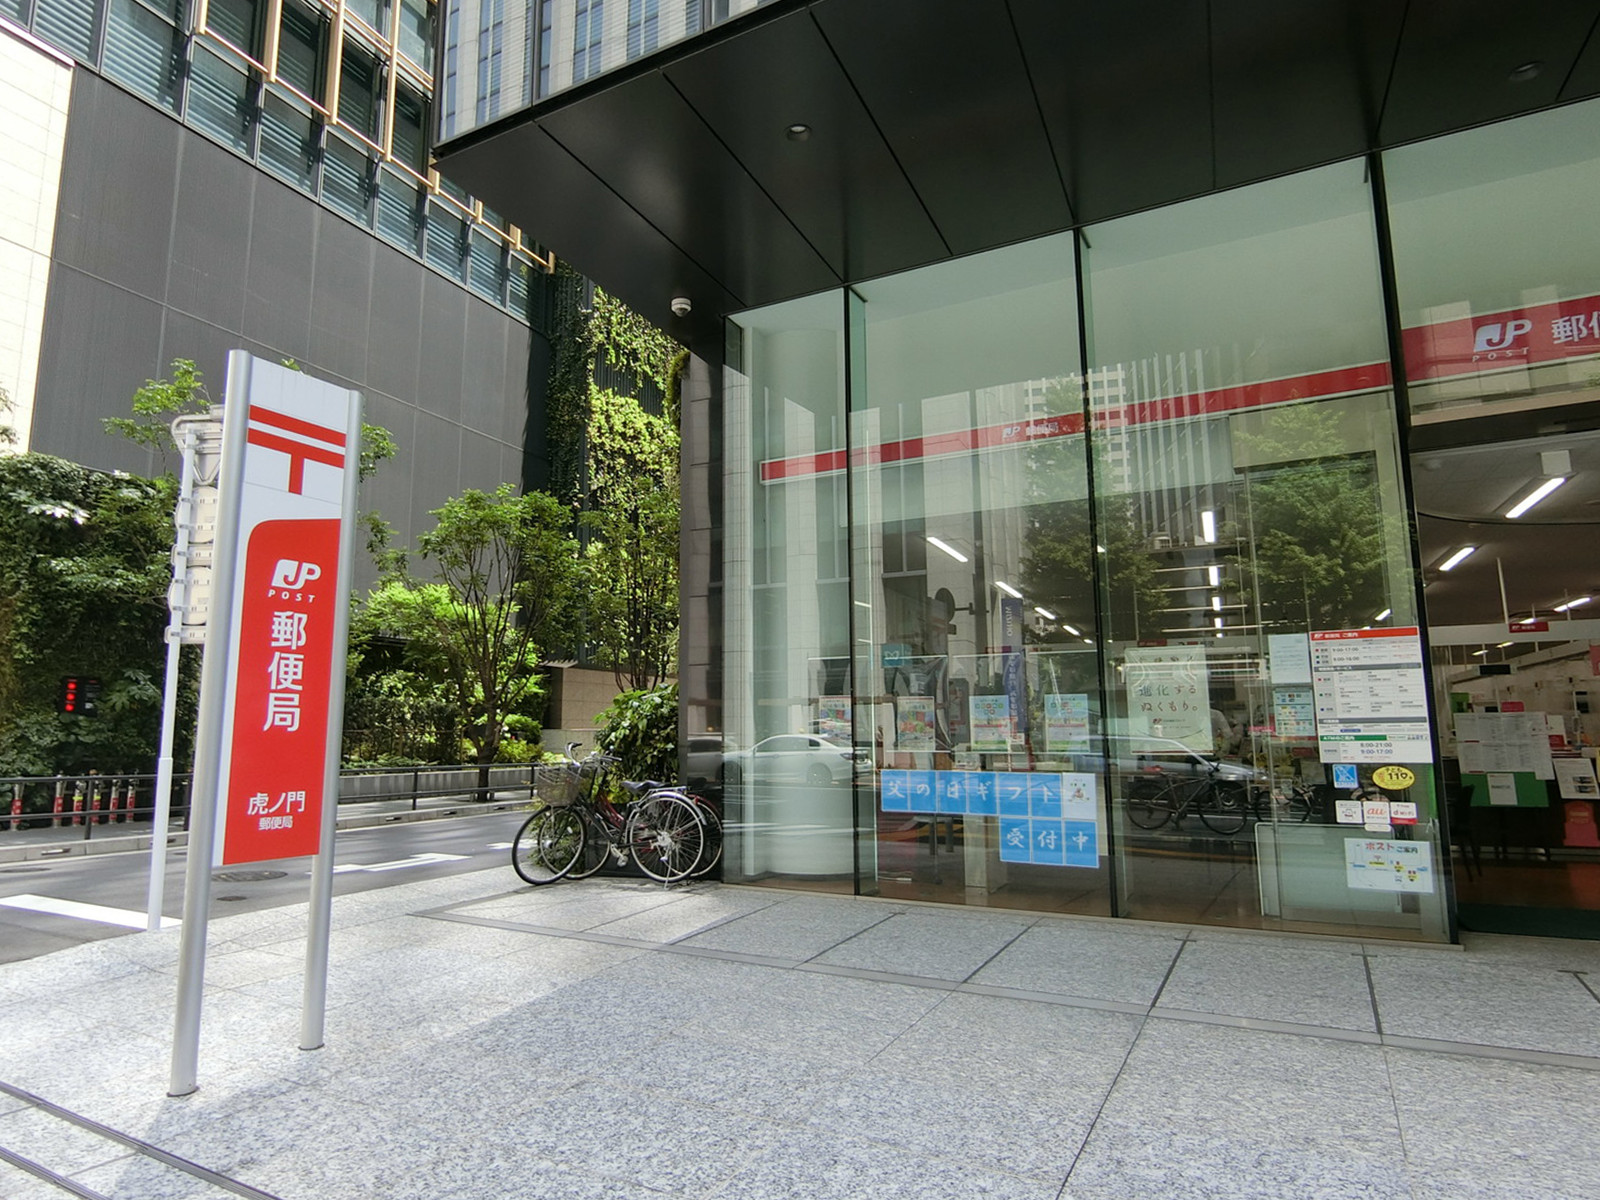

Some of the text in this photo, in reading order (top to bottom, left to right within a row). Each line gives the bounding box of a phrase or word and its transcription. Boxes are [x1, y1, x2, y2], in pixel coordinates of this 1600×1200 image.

[1473, 319, 1533, 353] JP
[1472, 347, 1530, 362] POST
[271, 558, 321, 590] JP
[268, 589, 316, 603] POST
[263, 611, 308, 732] 郵便局
[1139, 684, 1197, 697] 進化する
[887, 780, 1055, 803] 父の日ギフト
[247, 791, 306, 816] 虎ノ門
[258, 816, 293, 831] 郵便局
[1006, 828, 1089, 851] 受付中
[1365, 842, 1394, 851] ポスト
